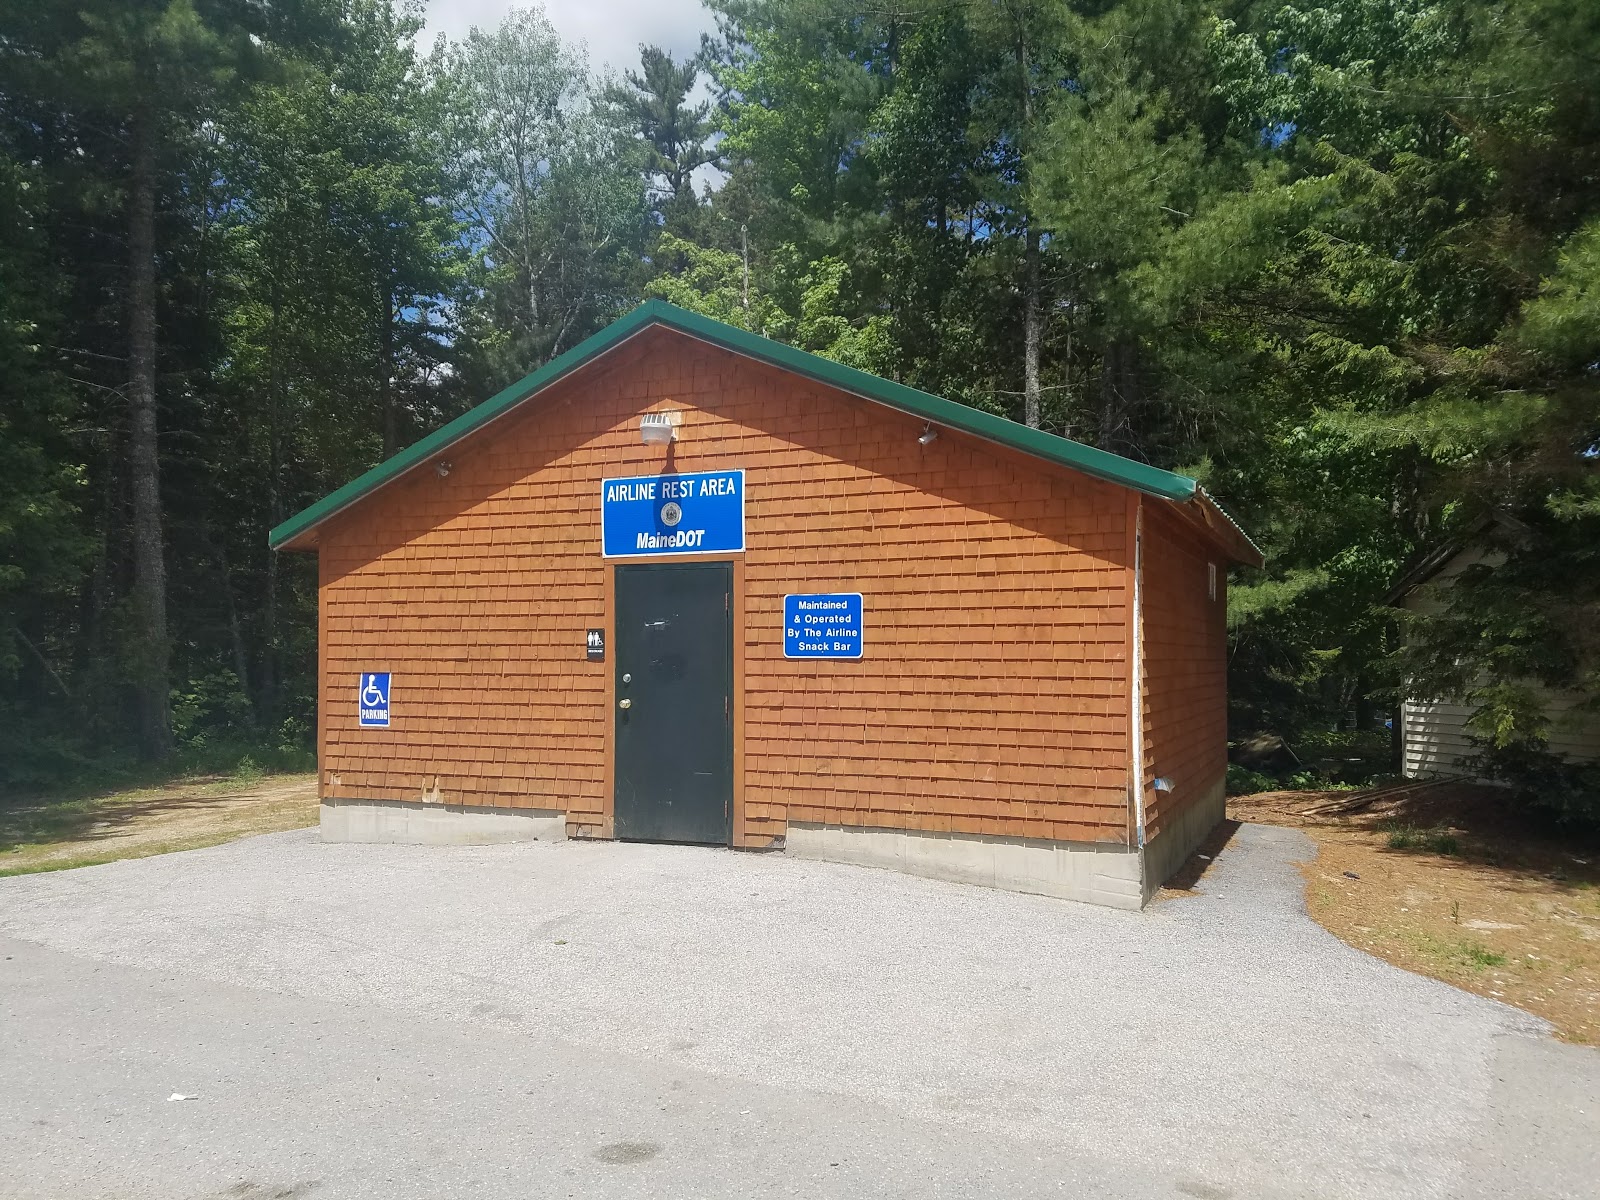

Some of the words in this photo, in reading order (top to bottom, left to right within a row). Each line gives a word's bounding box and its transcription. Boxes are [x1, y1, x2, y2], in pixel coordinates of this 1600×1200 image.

[607, 483, 656, 502] AIRLINE
[662, 480, 695, 498] REST
[699, 477, 736, 496] AREA
[636, 530, 705, 549] MaineDOT
[798, 600, 847, 610] Maintained
[794, 614, 800, 623] &
[804, 614, 852, 624] Operated
[787, 628, 800, 639] By
[804, 628, 822, 637] The
[825, 628, 858, 637] Airline
[798, 641, 830, 651] Snack
[833, 641, 851, 651] Bar
[362, 709, 388, 720] PARKING
